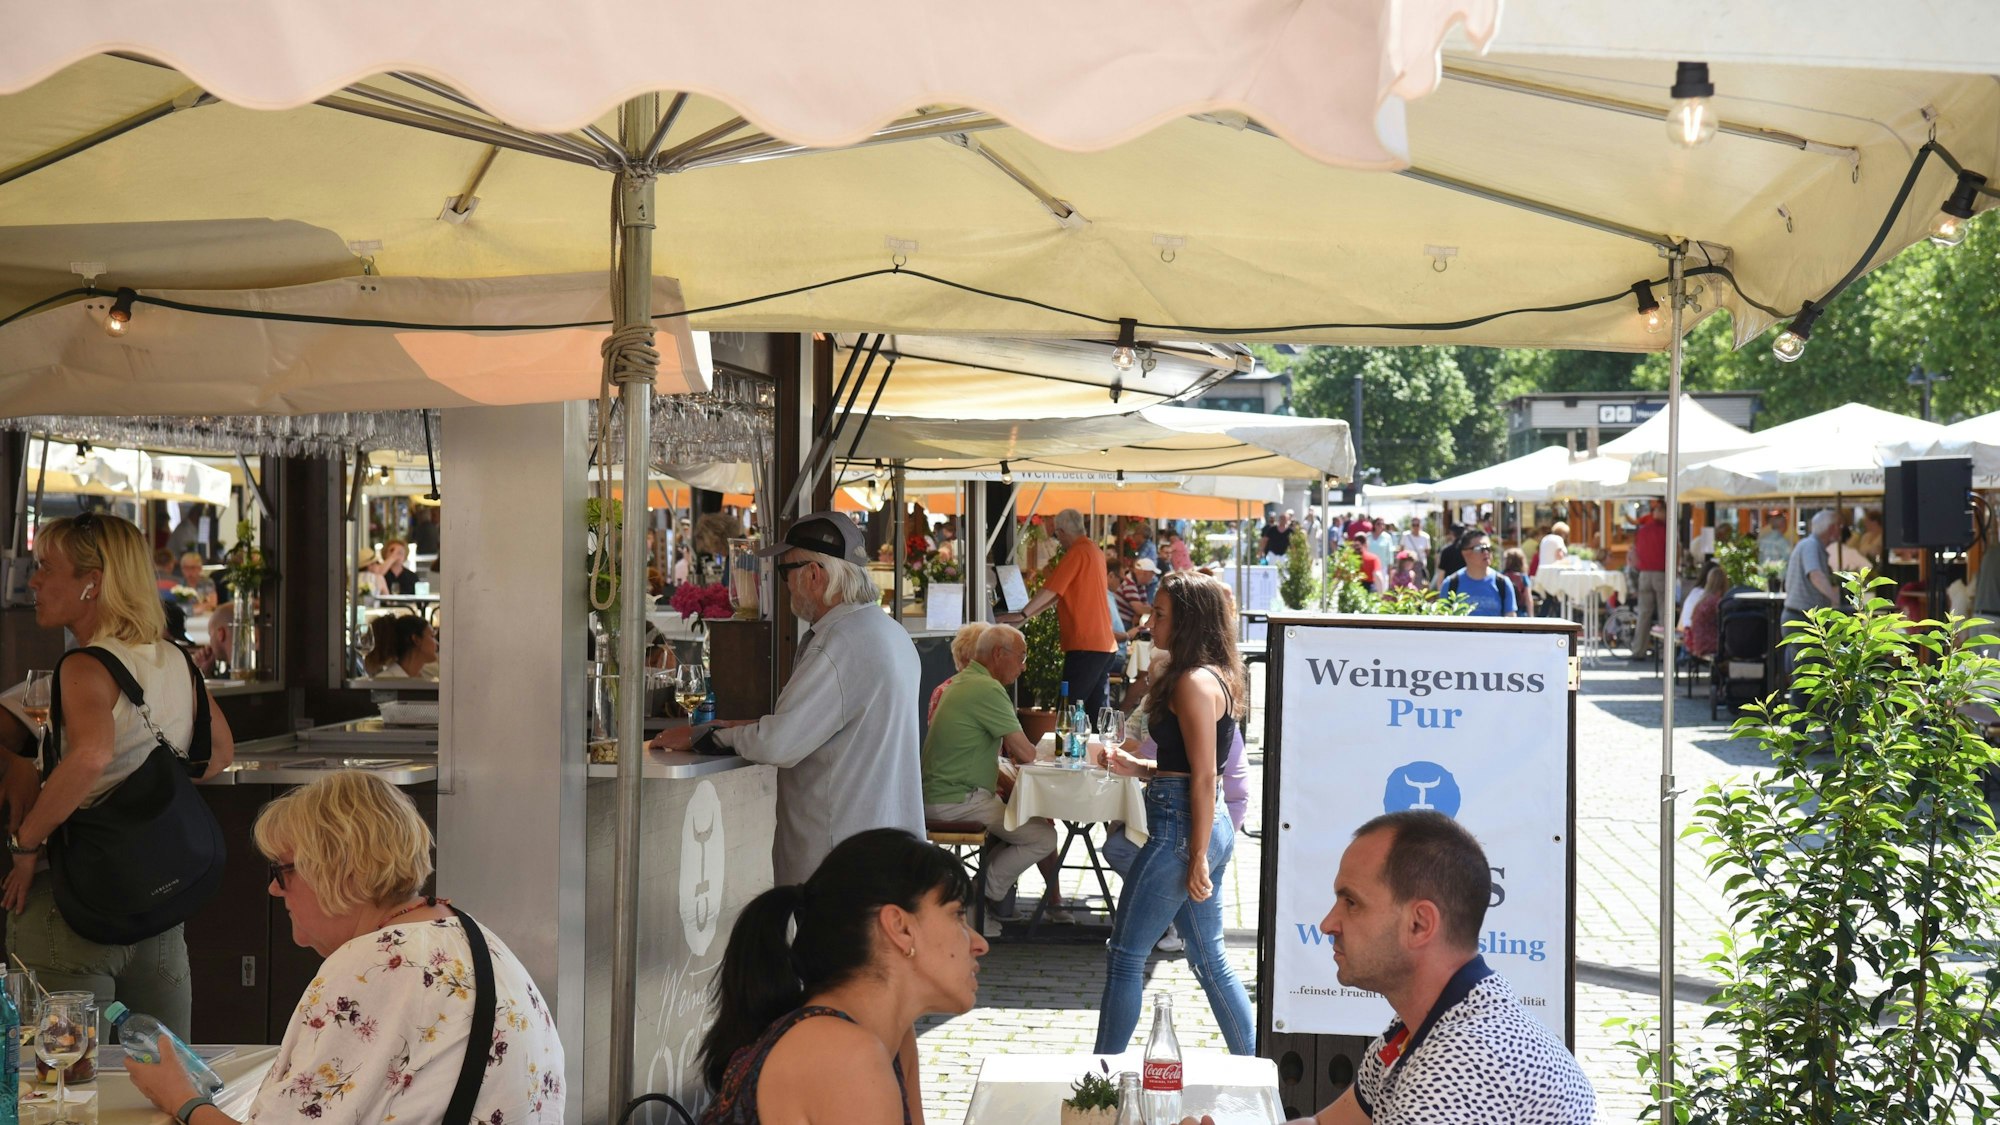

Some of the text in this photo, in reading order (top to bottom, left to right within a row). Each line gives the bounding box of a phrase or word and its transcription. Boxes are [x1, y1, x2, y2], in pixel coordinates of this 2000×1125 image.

[1305, 658, 1545, 696] Weingenuss
[1386, 698, 1463, 729] Pur
[1478, 931, 1546, 962] sling
[1340, 988, 1378, 999] Frucht
[1520, 996, 1547, 1007] lität
[1145, 1063, 1182, 1080] Coca-Cola
